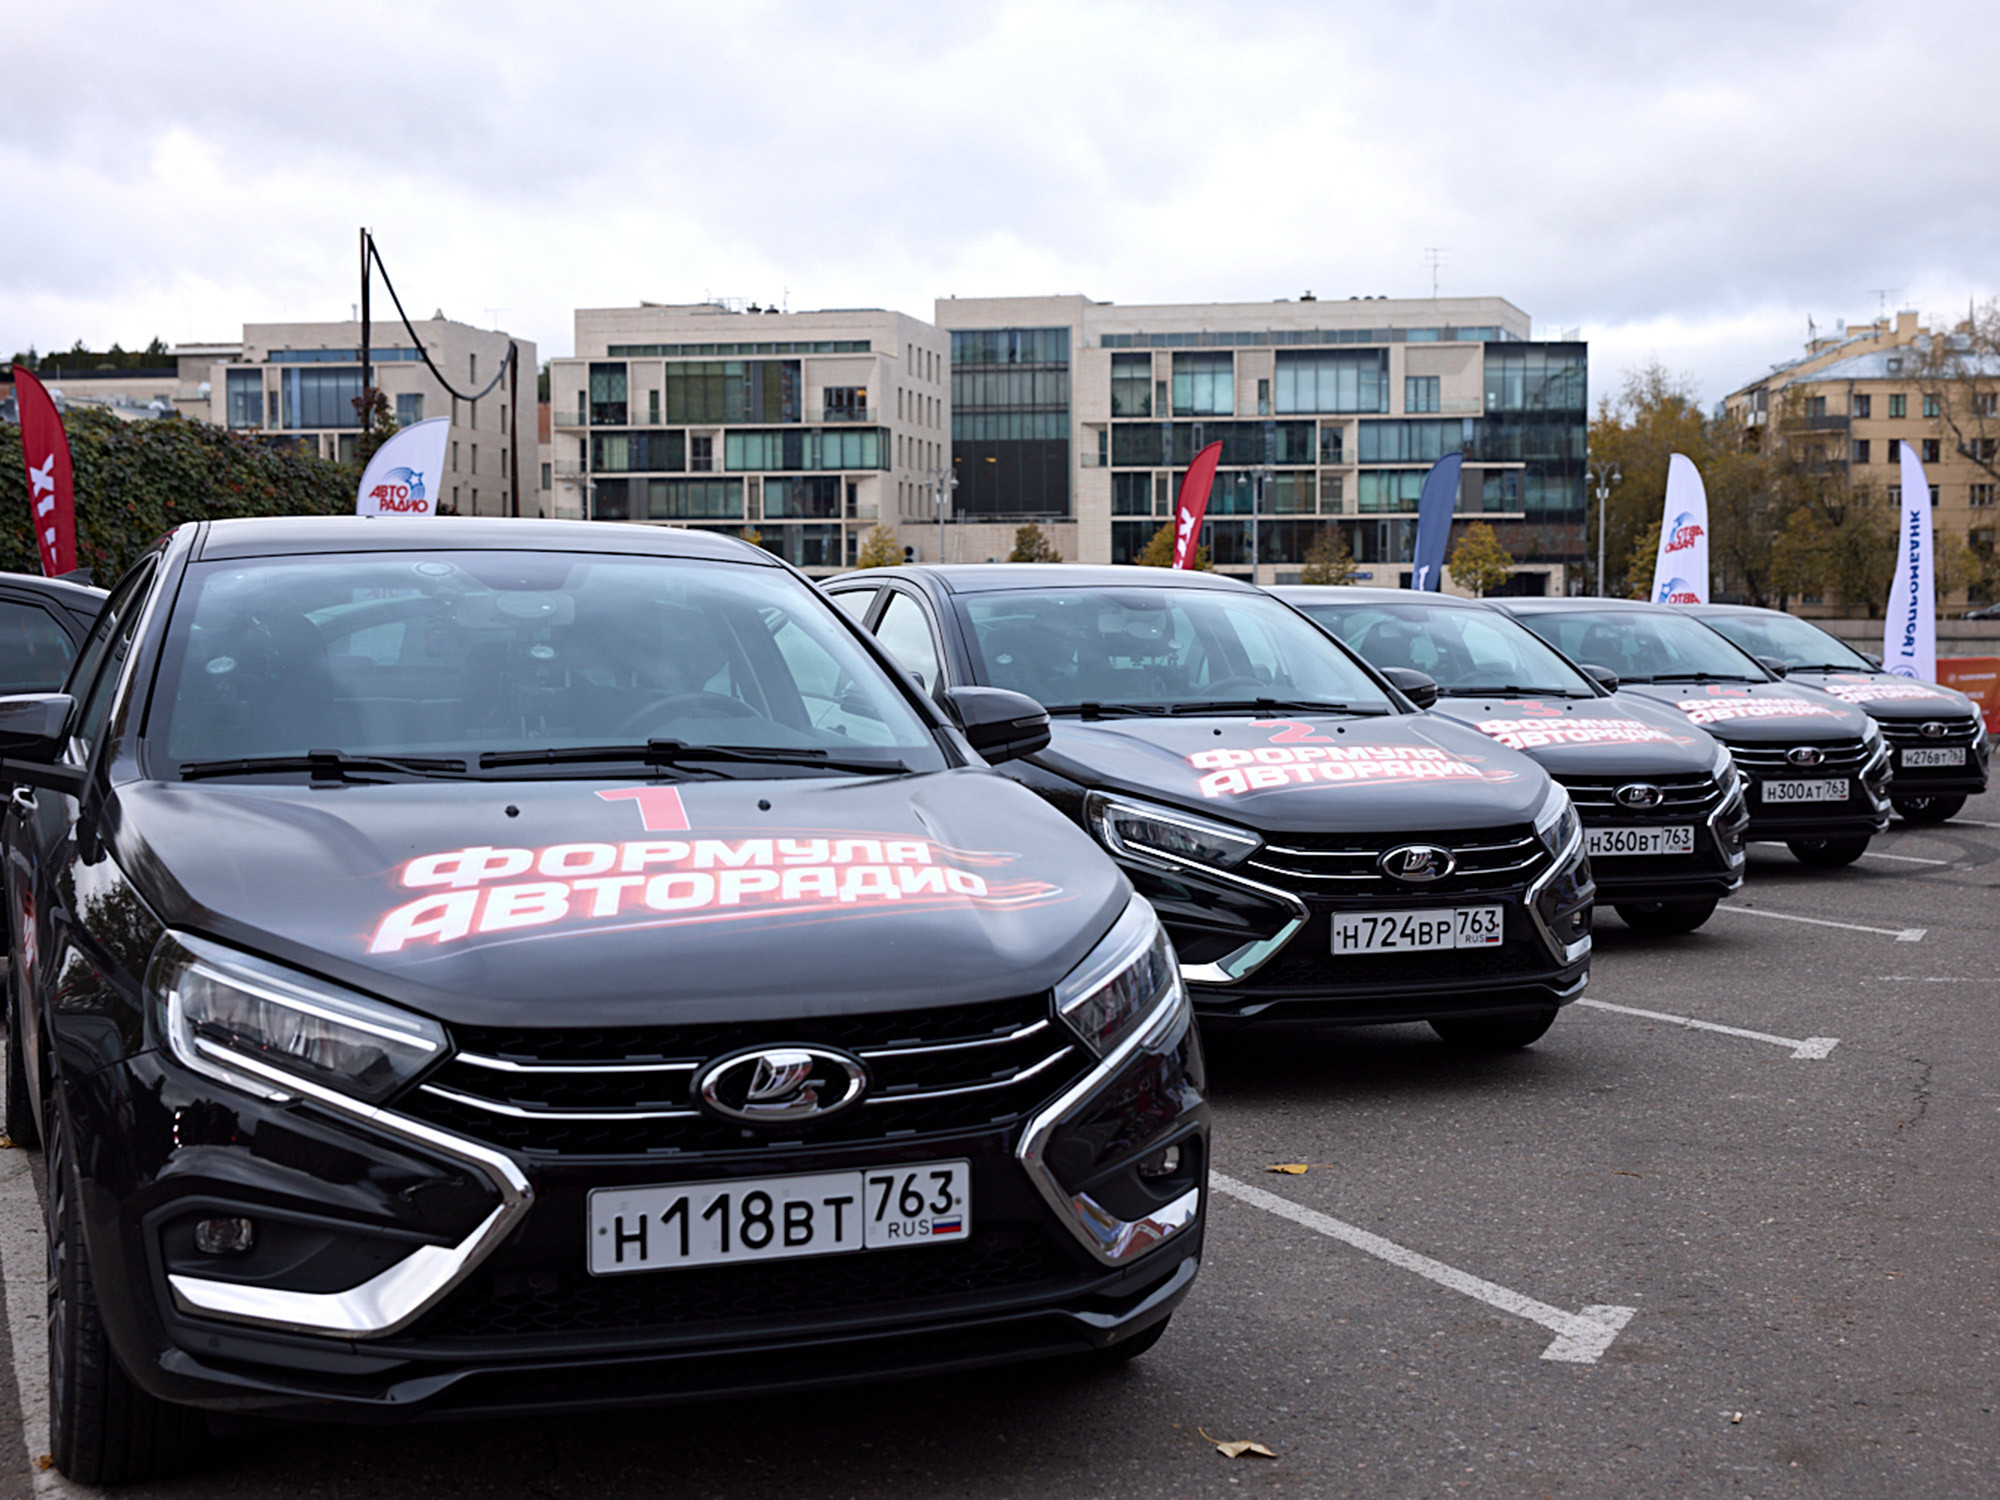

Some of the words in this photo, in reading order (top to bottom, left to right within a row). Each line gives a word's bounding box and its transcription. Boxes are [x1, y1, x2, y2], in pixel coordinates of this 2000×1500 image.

[368, 485, 409, 499] АВТО
[379, 498, 429, 513] РАДИО
[1503, 700, 1563, 717] 3
[1686, 706, 1831, 725] АВТОРАД
[1249, 720, 1335, 743] 2
[1190, 747, 1449, 769] ФОРМУЛА
[1199, 760, 1482, 798] АВТОРАДИО
[1767, 782, 1823, 800] Н300АТ
[1825, 781, 1847, 794] 763
[594, 786, 692, 831] 1
[1590, 831, 1660, 852] Н360ВТ
[1664, 828, 1690, 845] 763
[402, 838, 933, 889] ФОРМУЛА
[366, 864, 989, 954] АВТОРАДИО
[1342, 915, 1451, 949] Н724ВР
[1457, 910, 1497, 935] 763
[1465, 934, 1485, 944] RUS
[614, 1190, 855, 1263] Н118ВТ
[868, 1170, 955, 1222] 763
[888, 1219, 930, 1239] RUS
